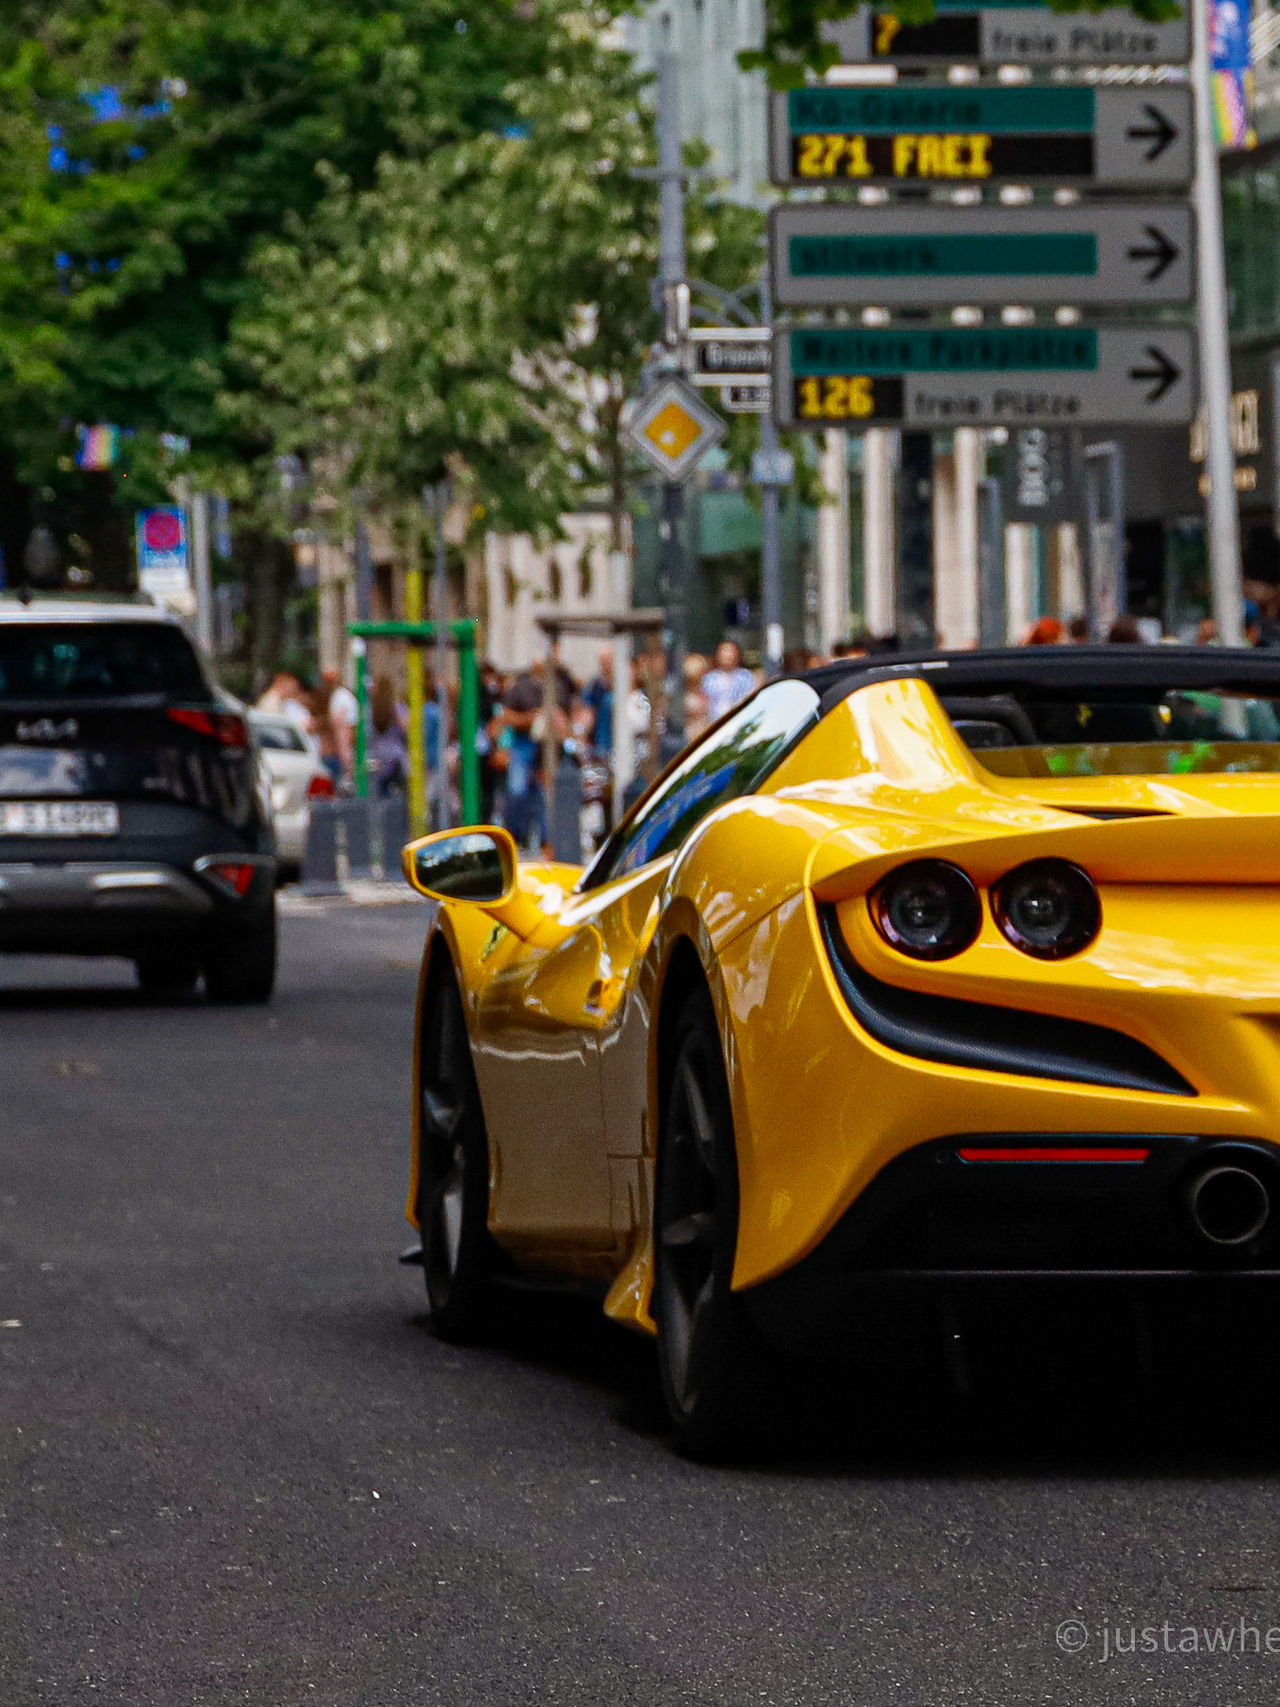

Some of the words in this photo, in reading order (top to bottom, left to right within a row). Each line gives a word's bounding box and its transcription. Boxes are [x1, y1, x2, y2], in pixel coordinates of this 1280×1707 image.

[992, 28, 1056, 54] freie
[1071, 27, 1156, 54] Plätze
[799, 134, 872, 177] 271
[801, 242, 936, 270] stilwerk
[802, 336, 912, 362] Weitere
[930, 336, 1087, 366] Parkplätze
[801, 376, 875, 418] 126
[915, 391, 980, 415] freie
[993, 389, 1080, 415] Plätze
